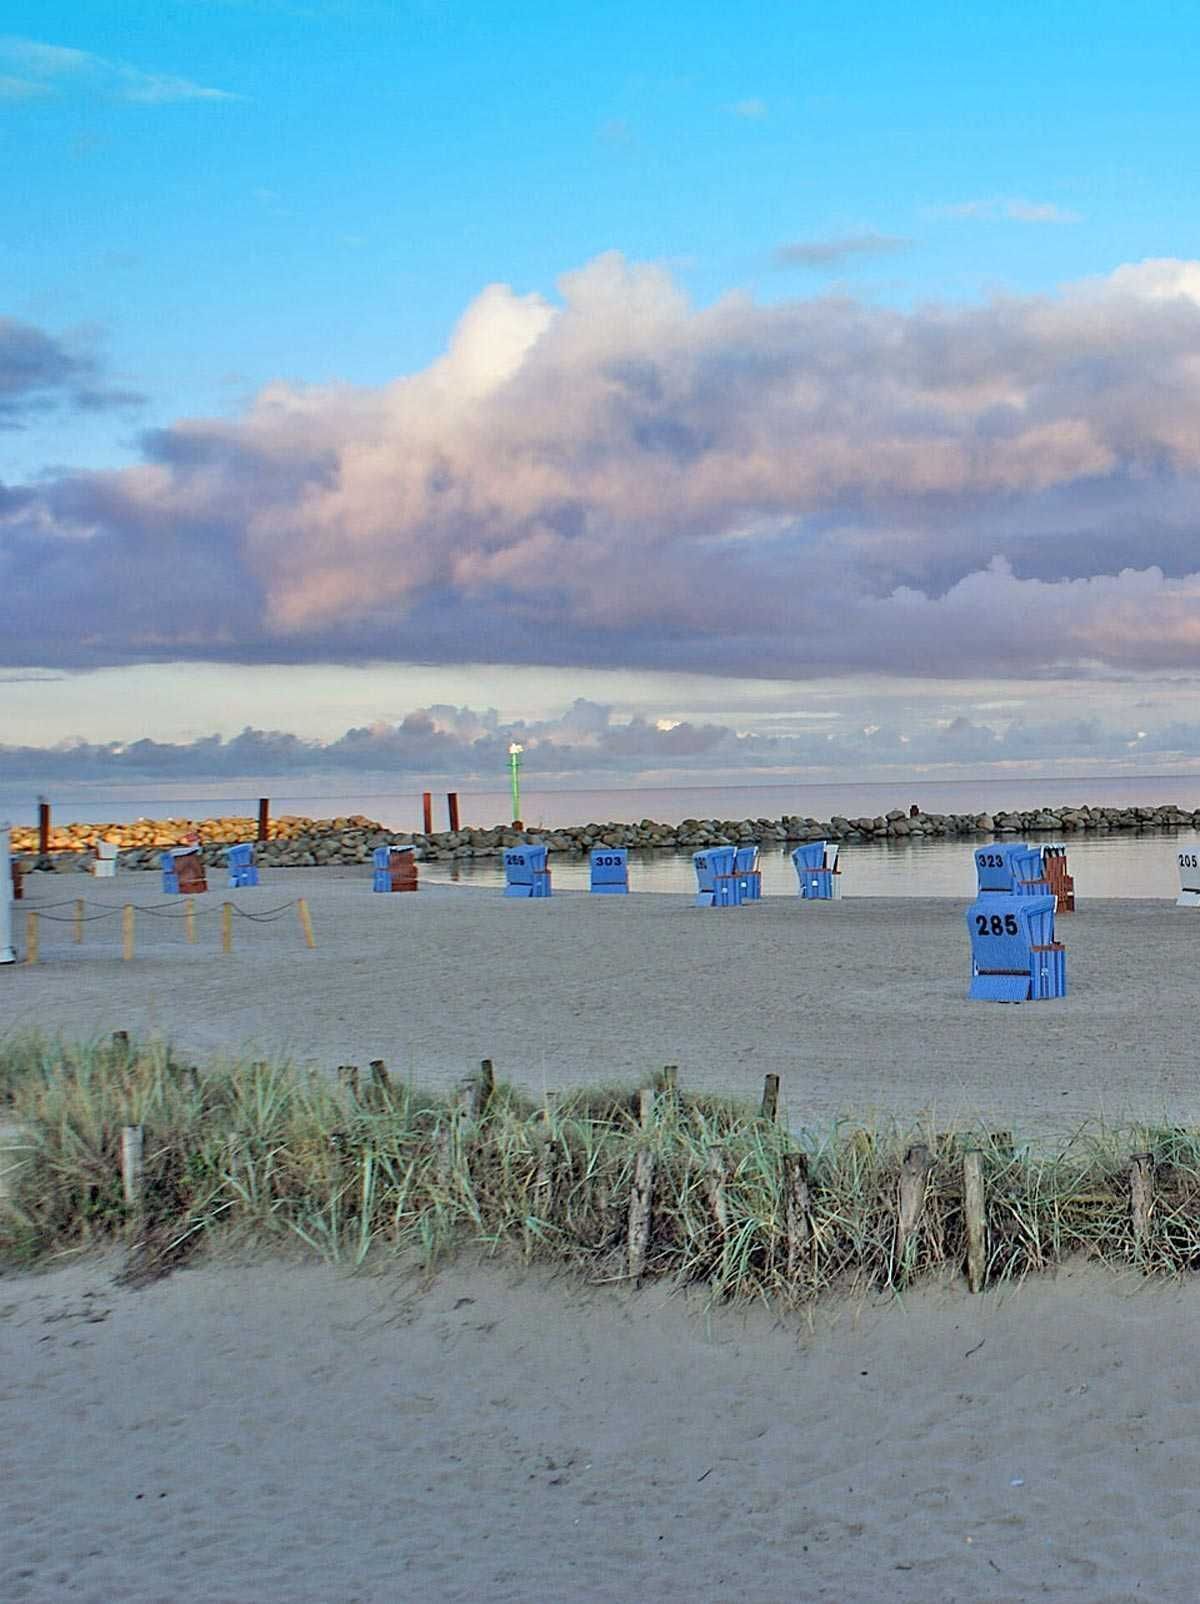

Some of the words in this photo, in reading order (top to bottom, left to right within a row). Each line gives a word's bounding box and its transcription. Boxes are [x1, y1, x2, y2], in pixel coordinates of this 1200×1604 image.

[595, 856, 622, 866] 303
[979, 854, 1004, 868] 323
[1179, 854, 1197, 868] 205
[975, 914, 1018, 936] 285
